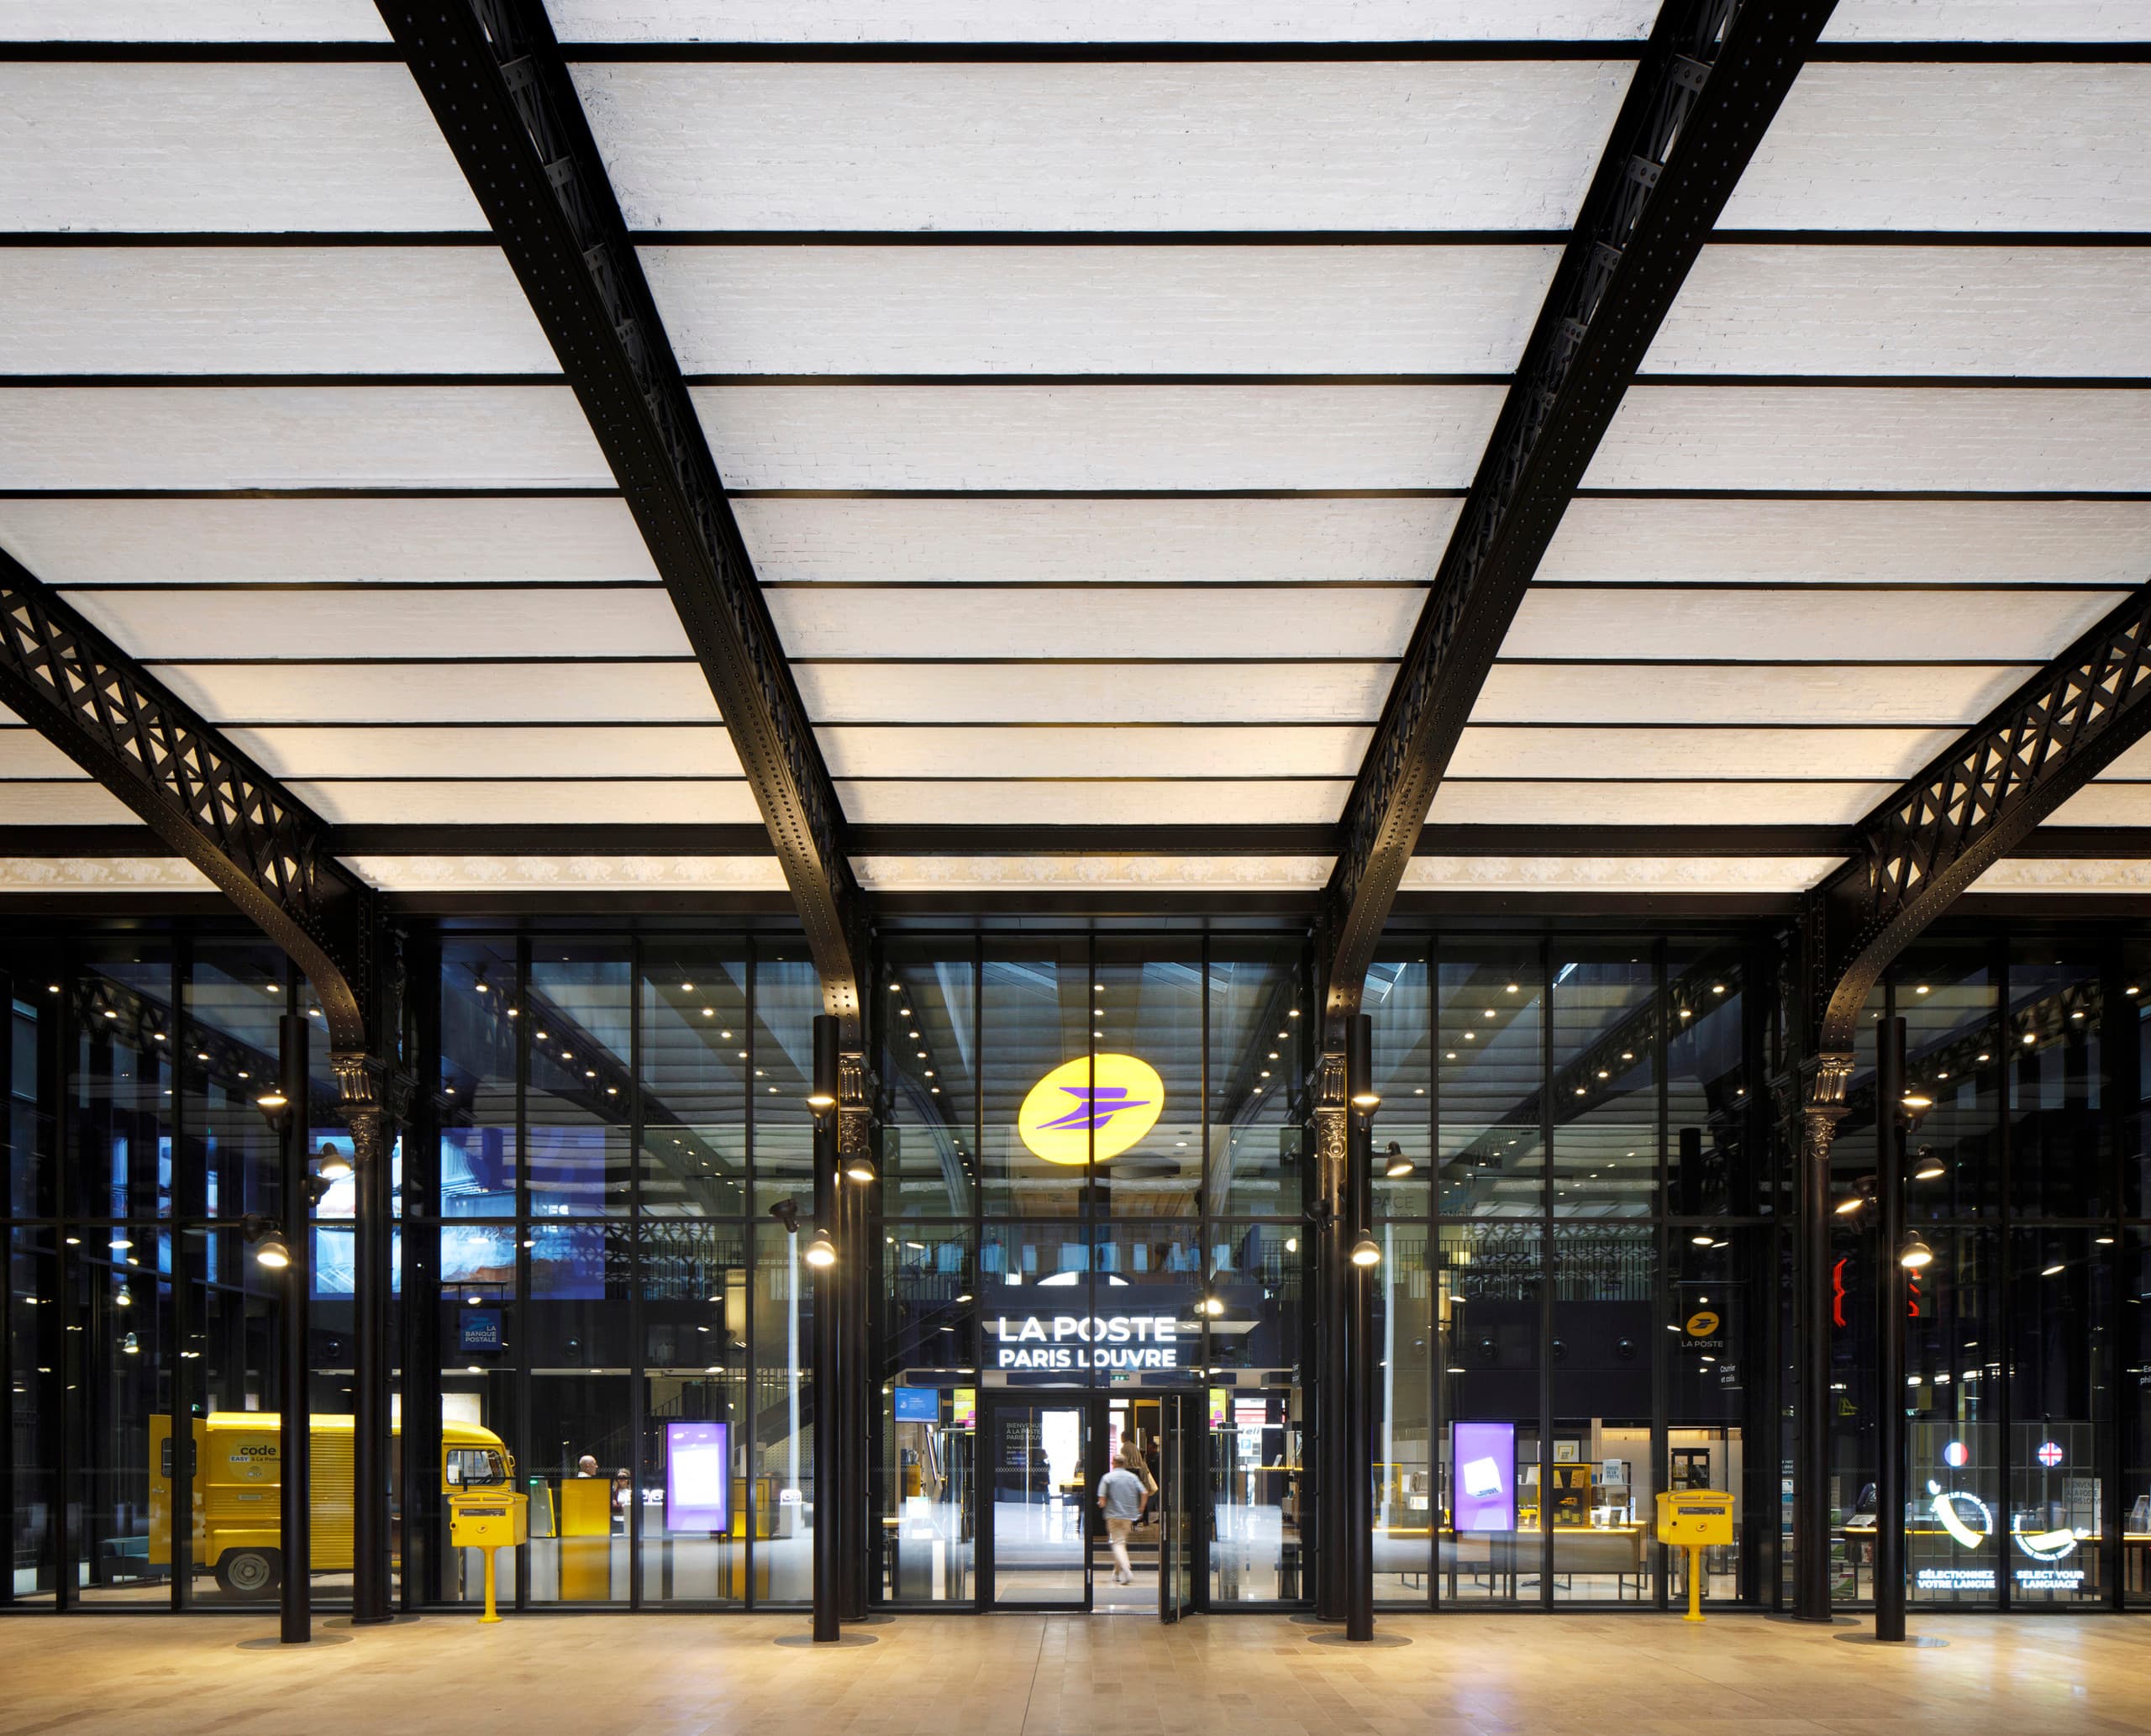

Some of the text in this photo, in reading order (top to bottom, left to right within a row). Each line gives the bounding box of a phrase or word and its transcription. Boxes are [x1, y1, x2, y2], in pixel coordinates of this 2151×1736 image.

[1371, 1196, 1414, 1209] PACE
[998, 1317, 1176, 1342] LA POSTE
[998, 1349, 1176, 1367] PARIS LOUVRE
[240, 1445, 276, 1455] code
[1918, 1569, 1995, 1580] SÉLECTIONNEZ
[2016, 1570, 2085, 1580] SELECT YOUR
[1917, 1580, 1996, 1589] VOTRE LANGUE
[2022, 1580, 2079, 1589] LANGUAGE
